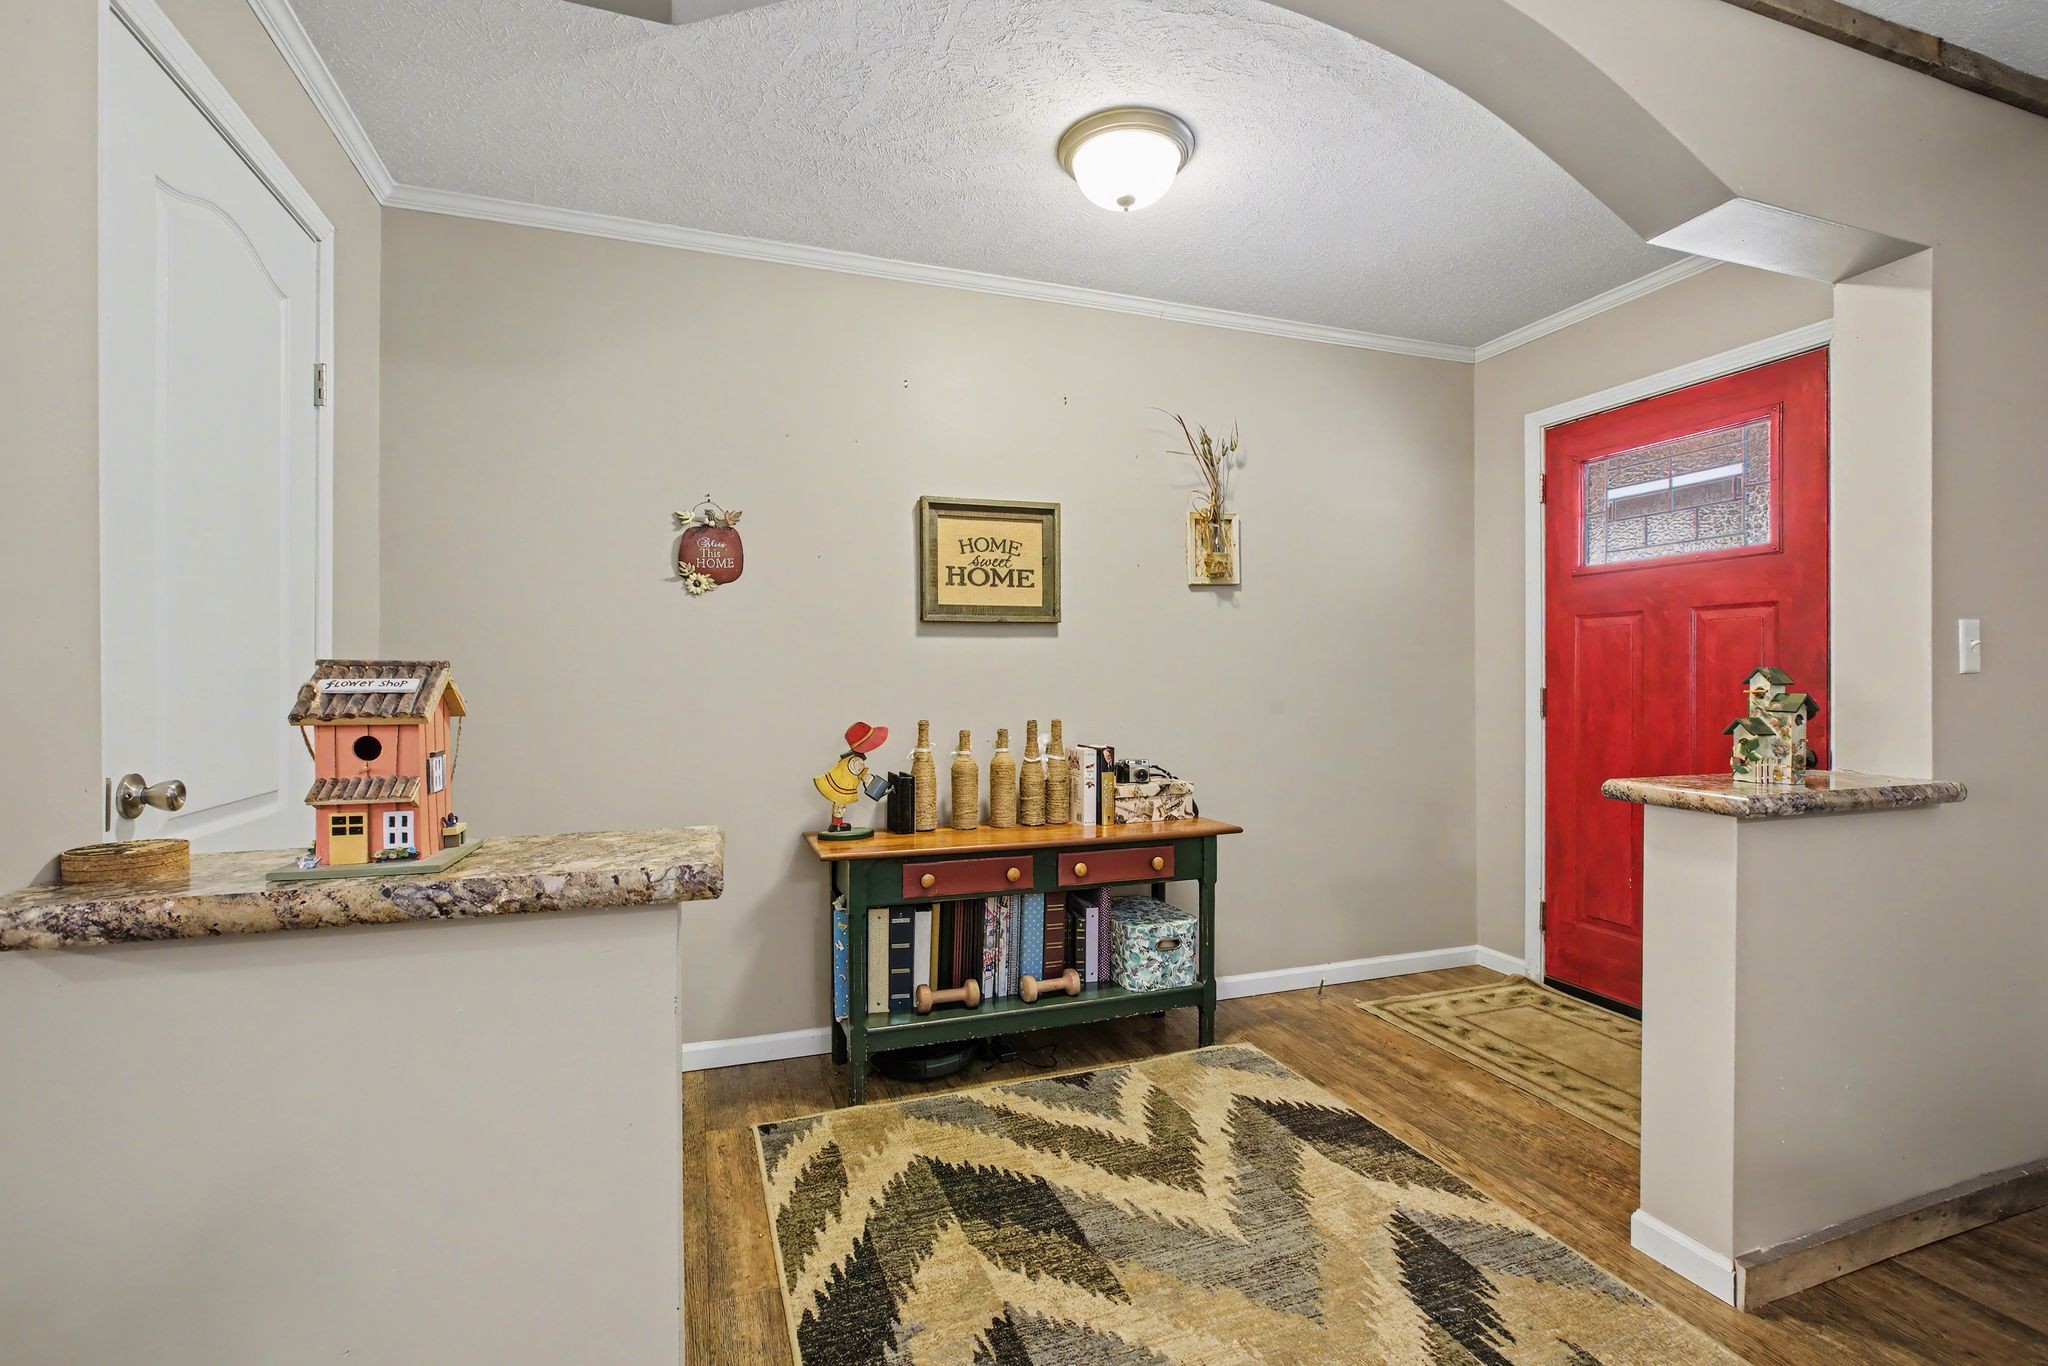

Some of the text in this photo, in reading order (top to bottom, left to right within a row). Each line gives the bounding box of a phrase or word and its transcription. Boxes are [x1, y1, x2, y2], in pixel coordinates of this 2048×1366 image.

[702, 549, 721, 558] This
[958, 537, 1022, 557] HOME
[696, 558, 735, 568] HOME
[968, 555, 1012, 568] sweet
[945, 565, 1035, 588] HOME
